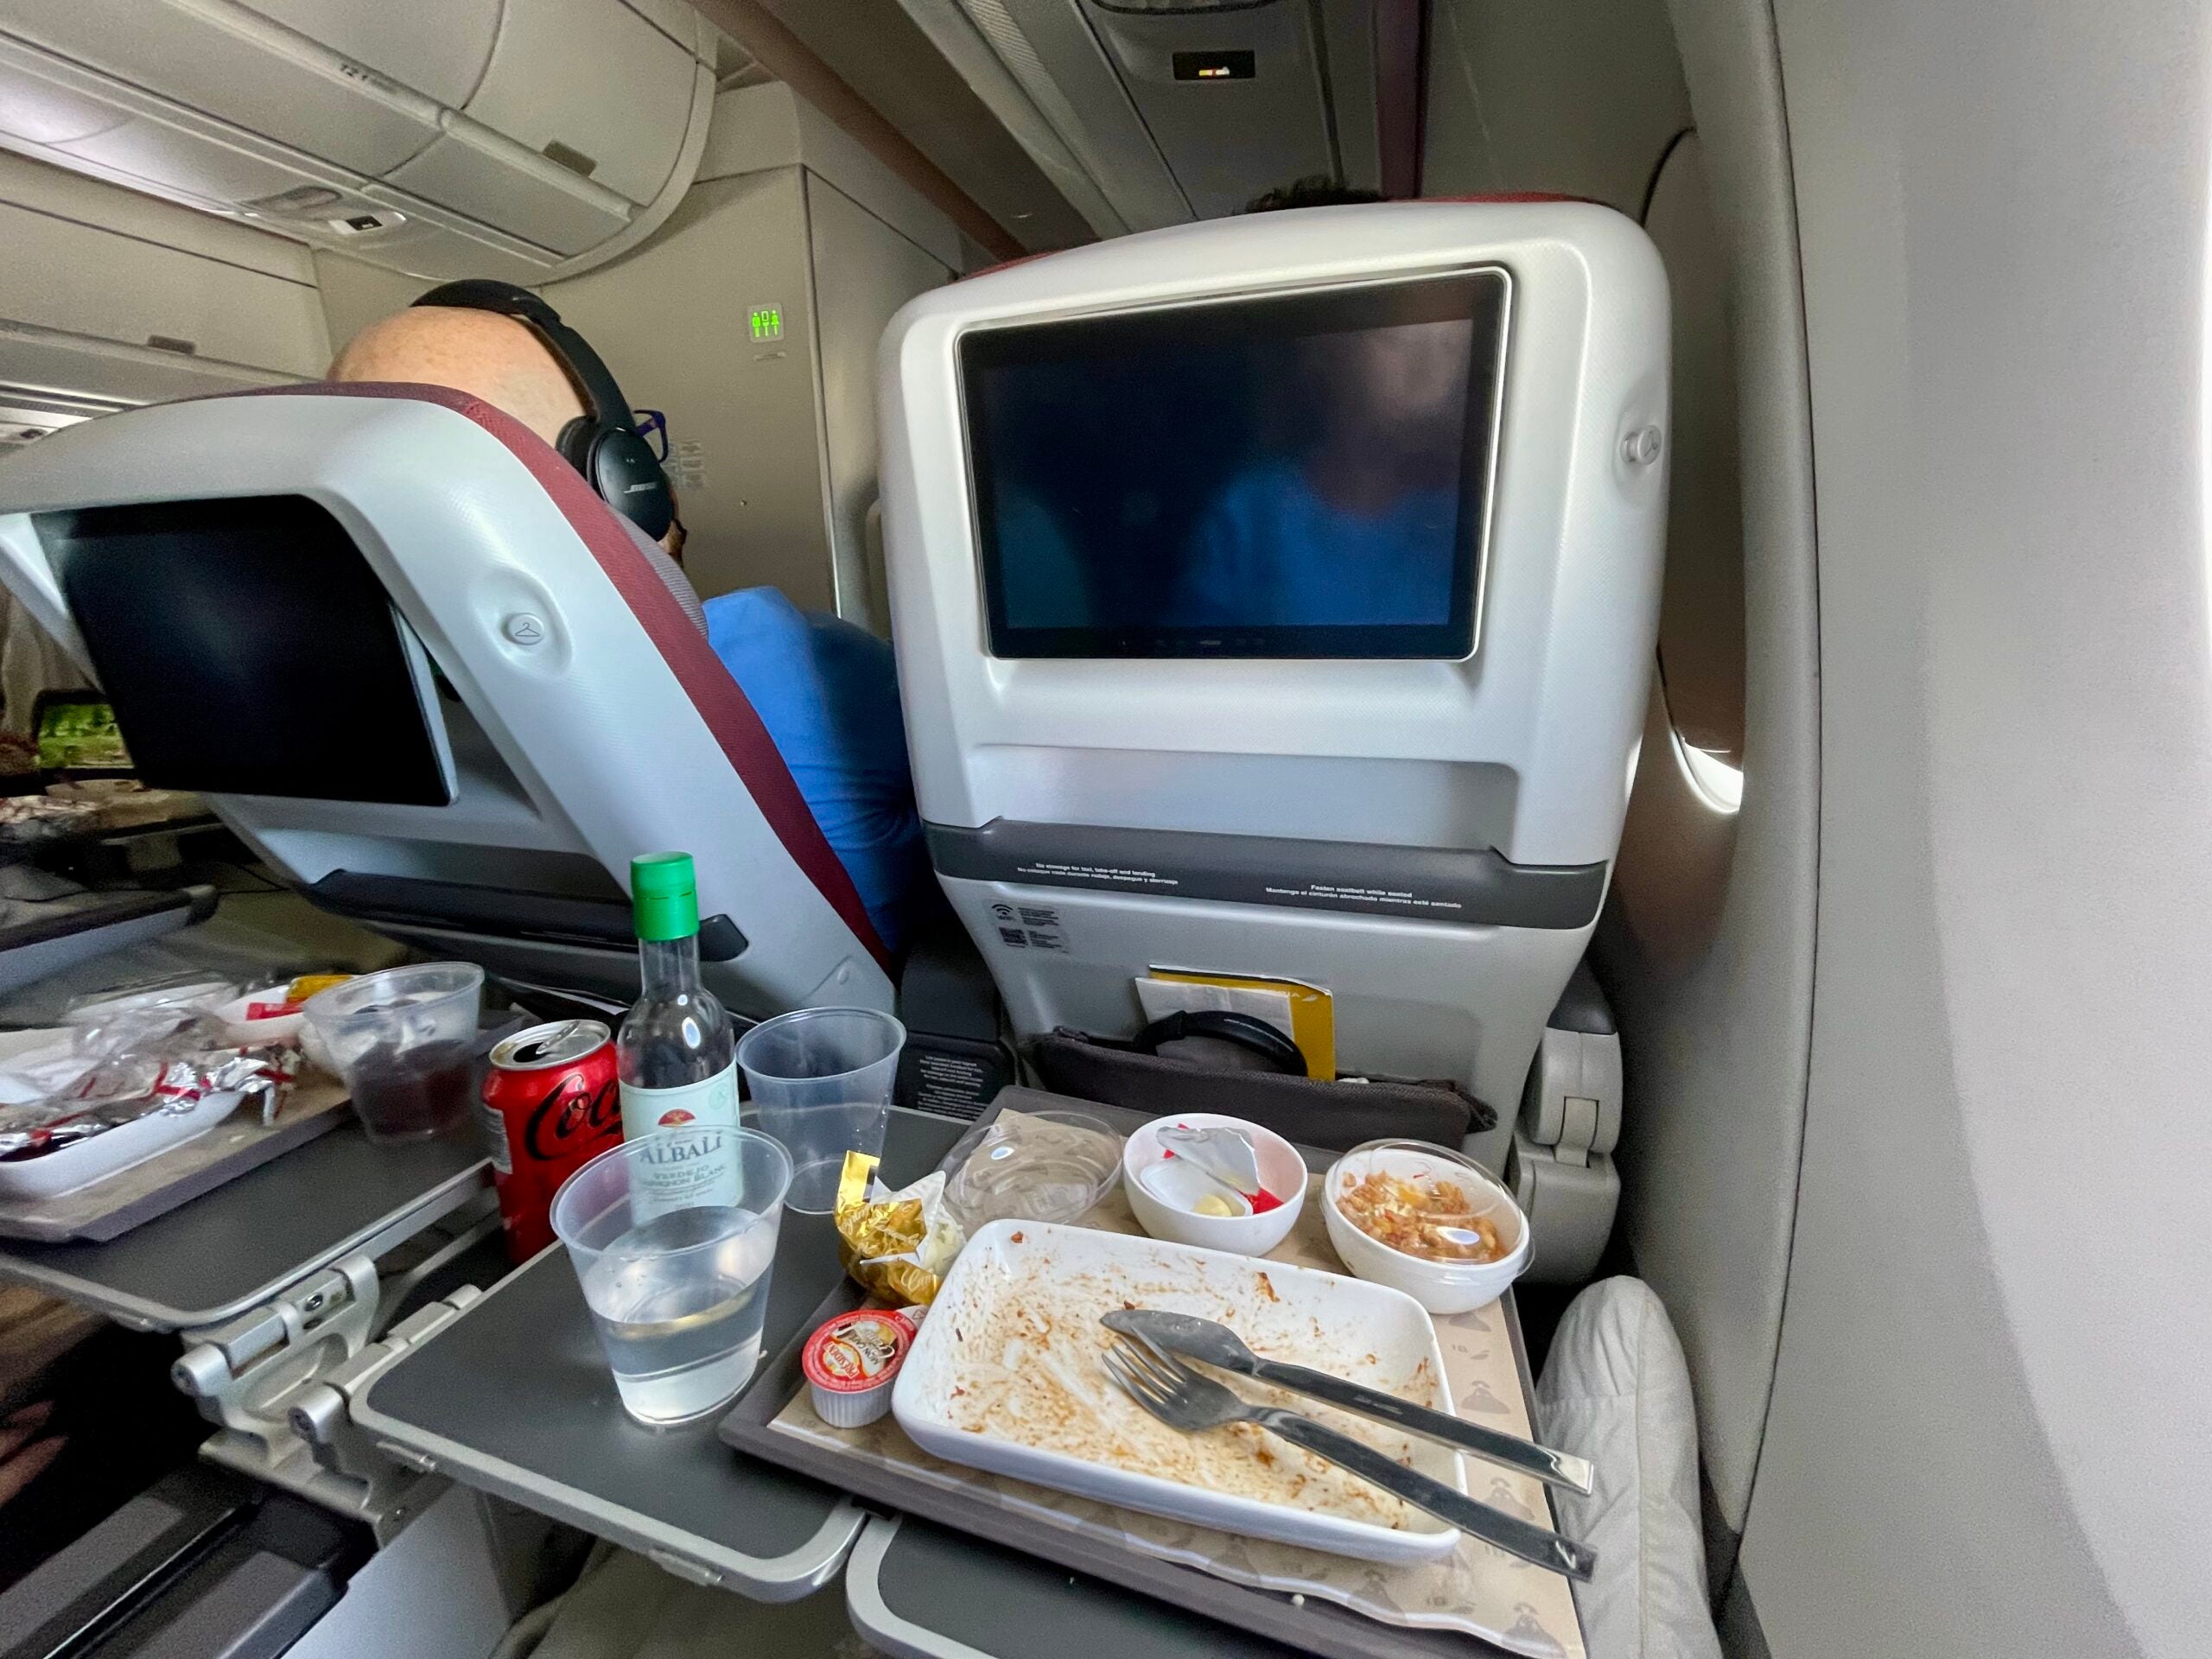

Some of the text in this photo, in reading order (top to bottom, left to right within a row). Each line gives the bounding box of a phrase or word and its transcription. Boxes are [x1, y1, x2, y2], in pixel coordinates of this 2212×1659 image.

[1266, 887, 1300, 896] Mantenga
[1339, 893, 1378, 902] abrochado
[1379, 896, 1412, 905] mientras
